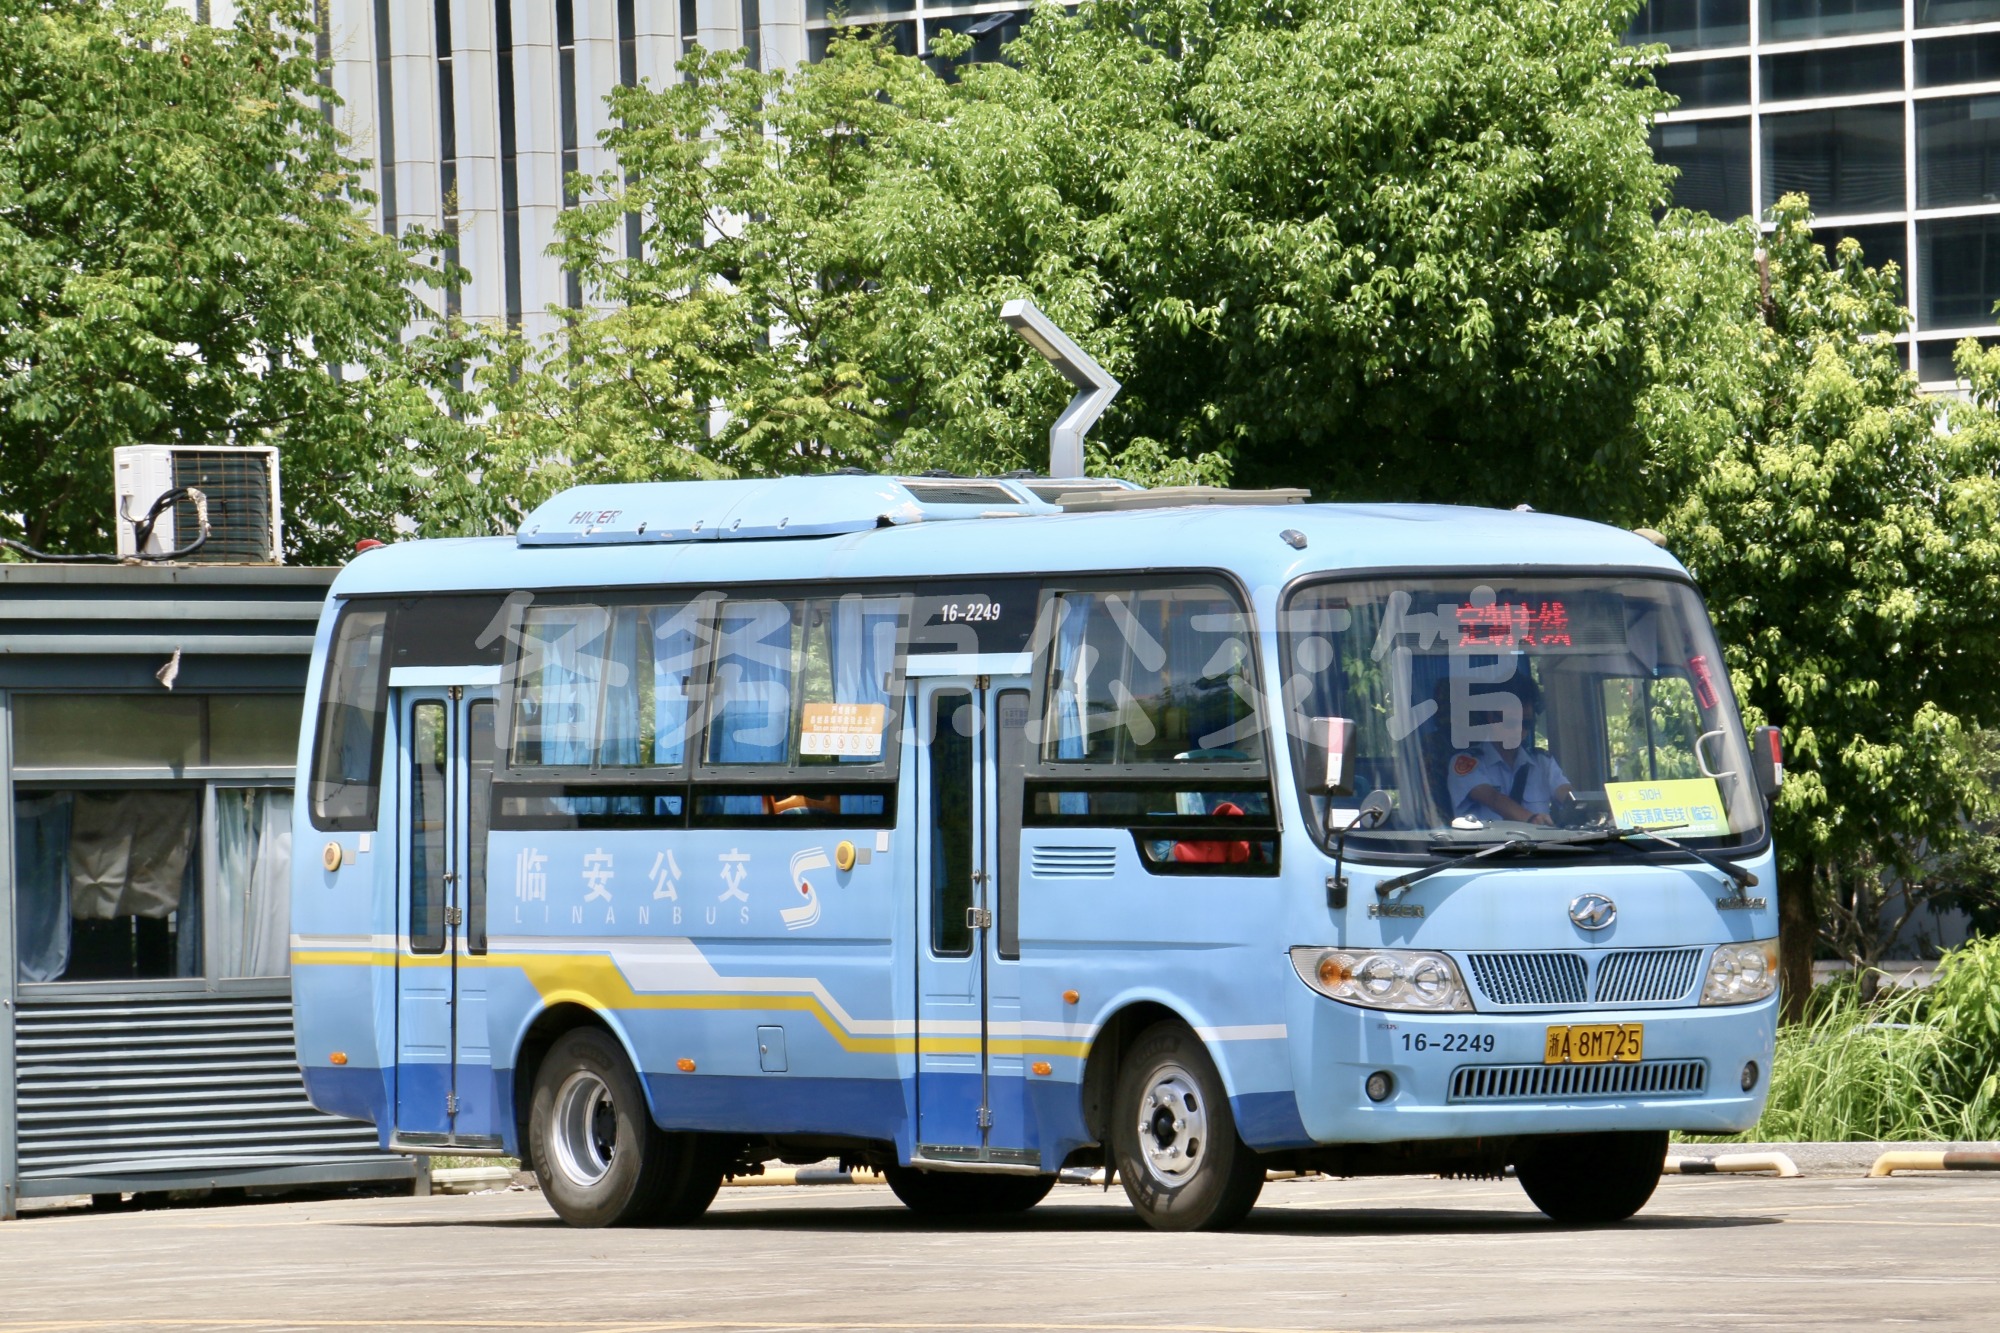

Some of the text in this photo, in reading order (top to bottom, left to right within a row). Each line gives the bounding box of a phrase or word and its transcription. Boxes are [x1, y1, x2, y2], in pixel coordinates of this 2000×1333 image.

[941, 602, 1001, 622] 16-2249
[515, 847, 752, 903] 临安公交
[1402, 1033, 1495, 1053] 16-2249
